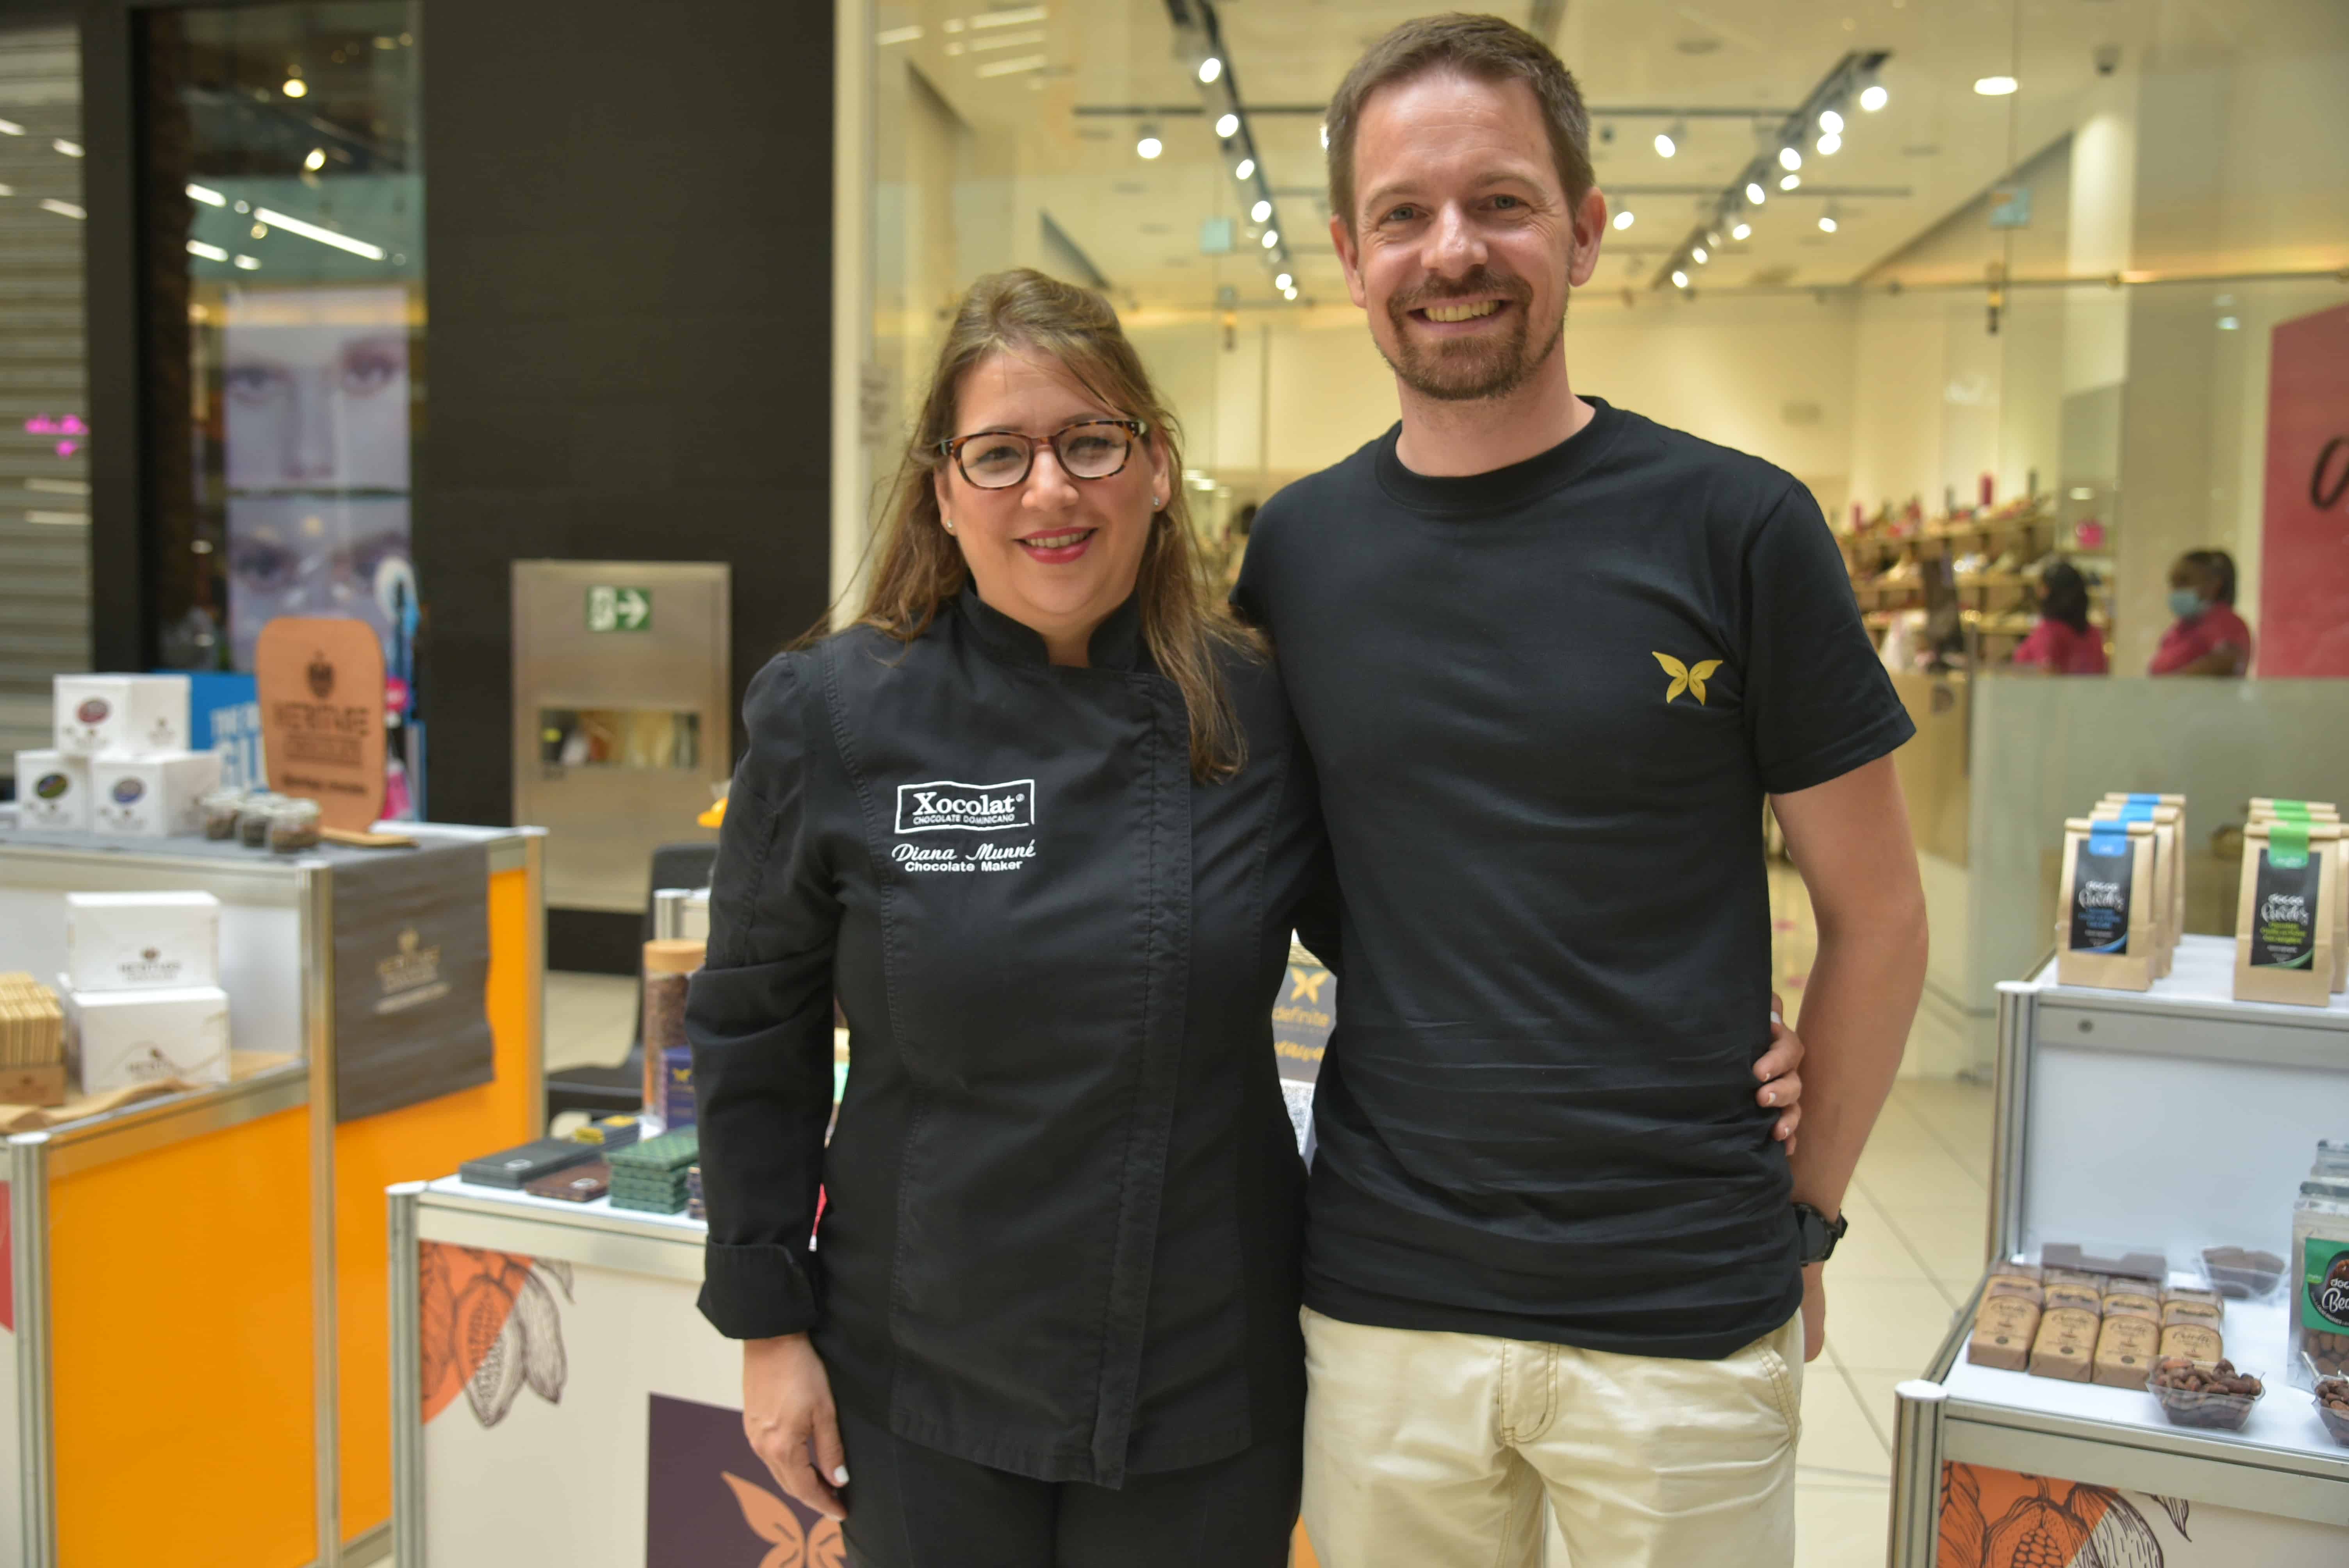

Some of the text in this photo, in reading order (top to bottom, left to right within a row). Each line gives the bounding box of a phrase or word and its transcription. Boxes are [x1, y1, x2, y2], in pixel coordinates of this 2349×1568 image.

[913, 813, 1015, 825] CHOCOLATE DOMINICANO
[891, 839, 1036, 862] Diana Munné
[904, 860, 1023, 872] Chocolate Maker
